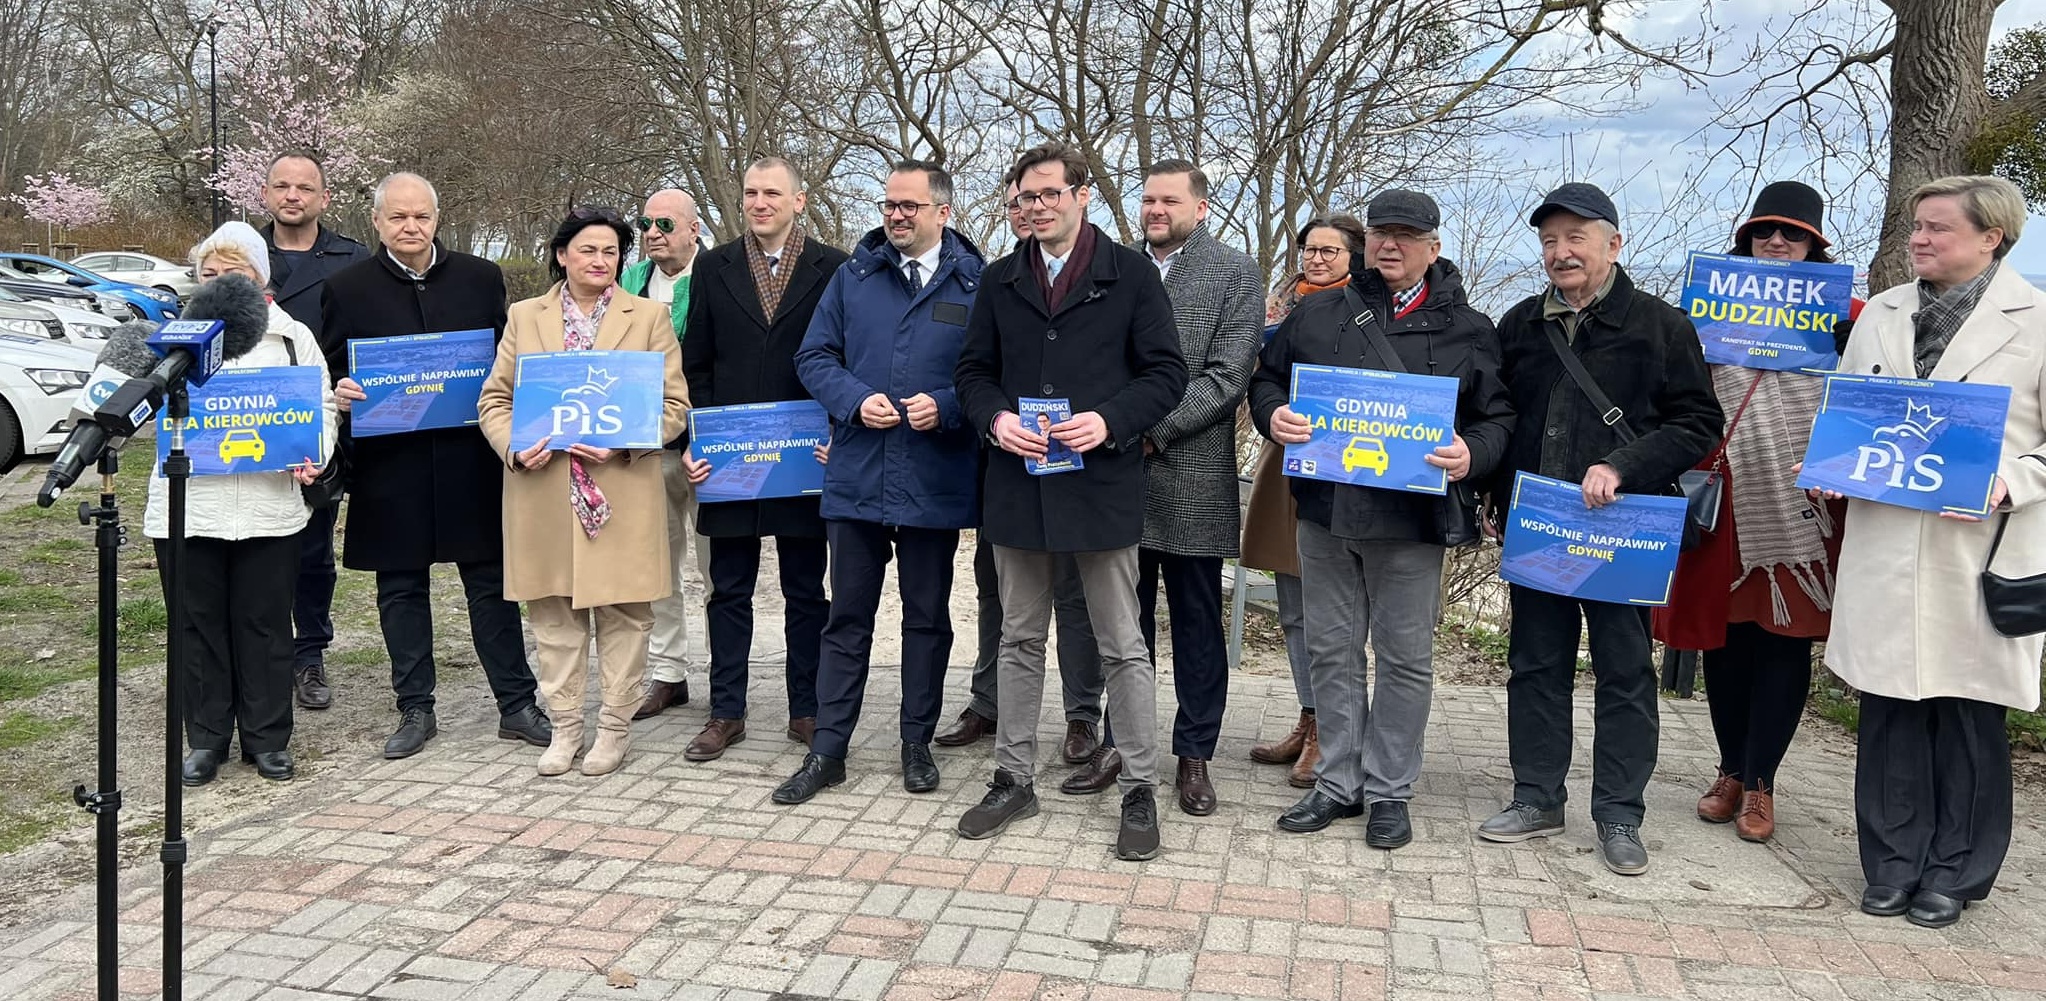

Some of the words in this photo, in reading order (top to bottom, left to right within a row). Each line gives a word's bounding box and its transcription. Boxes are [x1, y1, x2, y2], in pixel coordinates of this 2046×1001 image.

[1708, 270, 1827, 306] MAREK
[1690, 298, 1838, 334] DUDZIŃSKI
[1721, 336, 1755, 346] KANDYDAT
[1766, 341, 1807, 352] PREZYDENTA
[1747, 347, 1779, 358] GDYNI
[361, 374, 416, 387] WSPÓLNIE
[421, 368, 486, 381] NAPRAWIMY
[405, 383, 444, 395] GDYNIĘ
[205, 394, 278, 411] GDYNIA
[1021, 401, 1068, 412] DUDZIŃSKI
[1335, 397, 1408, 419] GDYNIA
[163, 416, 199, 431] DA
[203, 408, 314, 429] KIEROWCÓW
[550, 405, 623, 436] PiS
[1294, 412, 1327, 430] LA
[1331, 416, 1444, 443] KIEROWCÓW
[701, 441, 754, 454] WSPÓLNIE
[758, 438, 820, 451] NAPRAWIMY
[743, 452, 782, 463] GDYNIĘ
[1848, 446, 1945, 493] PiS
[1520, 517, 1583, 542] WSPÓLNIE
[1589, 534, 1668, 551] NAPRAWIMY
[1567, 544, 1615, 563] GDYNIĘ
